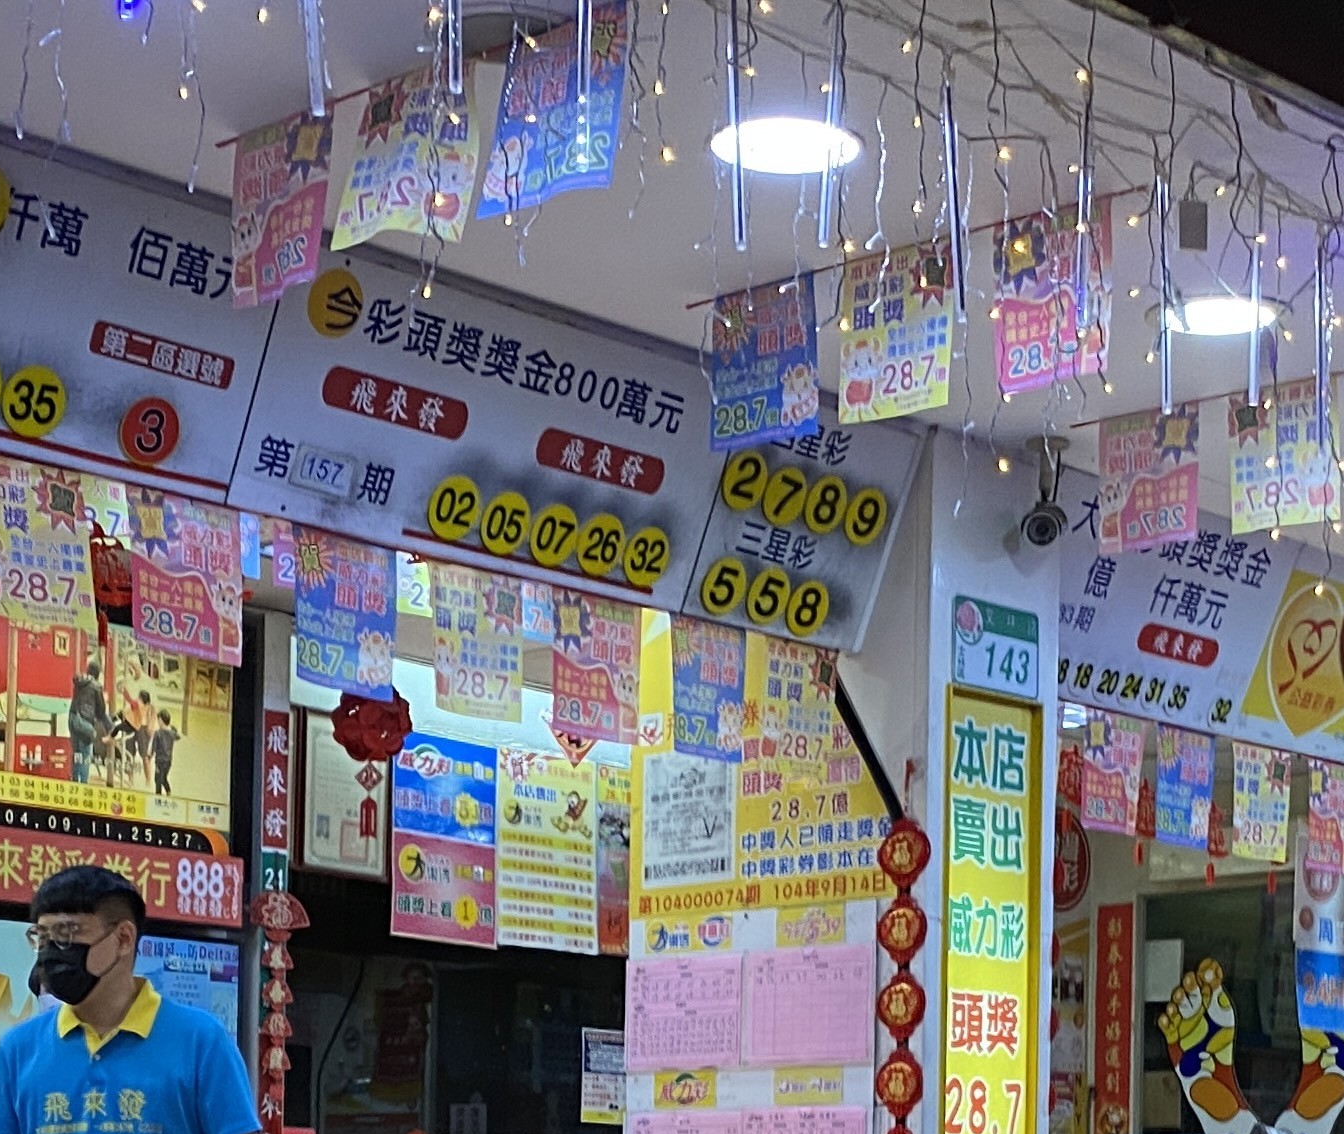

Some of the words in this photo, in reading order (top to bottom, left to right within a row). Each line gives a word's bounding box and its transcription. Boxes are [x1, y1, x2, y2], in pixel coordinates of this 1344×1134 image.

[99, 331, 226, 387] 第二區選號
[9, 384, 57, 425] 35
[133, 410, 165, 451] 3
[349, 381, 447, 433] 飛來發
[254, 434, 293, 480] 第
[303, 452, 347, 482] 157
[357, 462, 396, 507] 期
[560, 440, 646, 488] 飛來發
[434, 488, 478, 526] 02
[486, 506, 525, 543] 05
[537, 520, 576, 556] 07
[582, 527, 621, 564] 26
[631, 540, 665, 574] 32
[735, 521, 815, 569] 三星彩
[1084, 556, 1117, 599] 億
[1149, 573, 1231, 630] 仟萬元
[984, 646, 1030, 685] 143
[1074, 662, 1093, 689] 18
[1097, 666, 1118, 695] 20
[1121, 672, 1142, 699] 24
[952, 720, 1026, 793] 本店
[950, 798, 1024, 870] 賣出
[949, 898, 1025, 960] 威力彩
[951, 993, 1018, 1055] 頭獎
[43, 1086, 147, 1123] 飛來發
